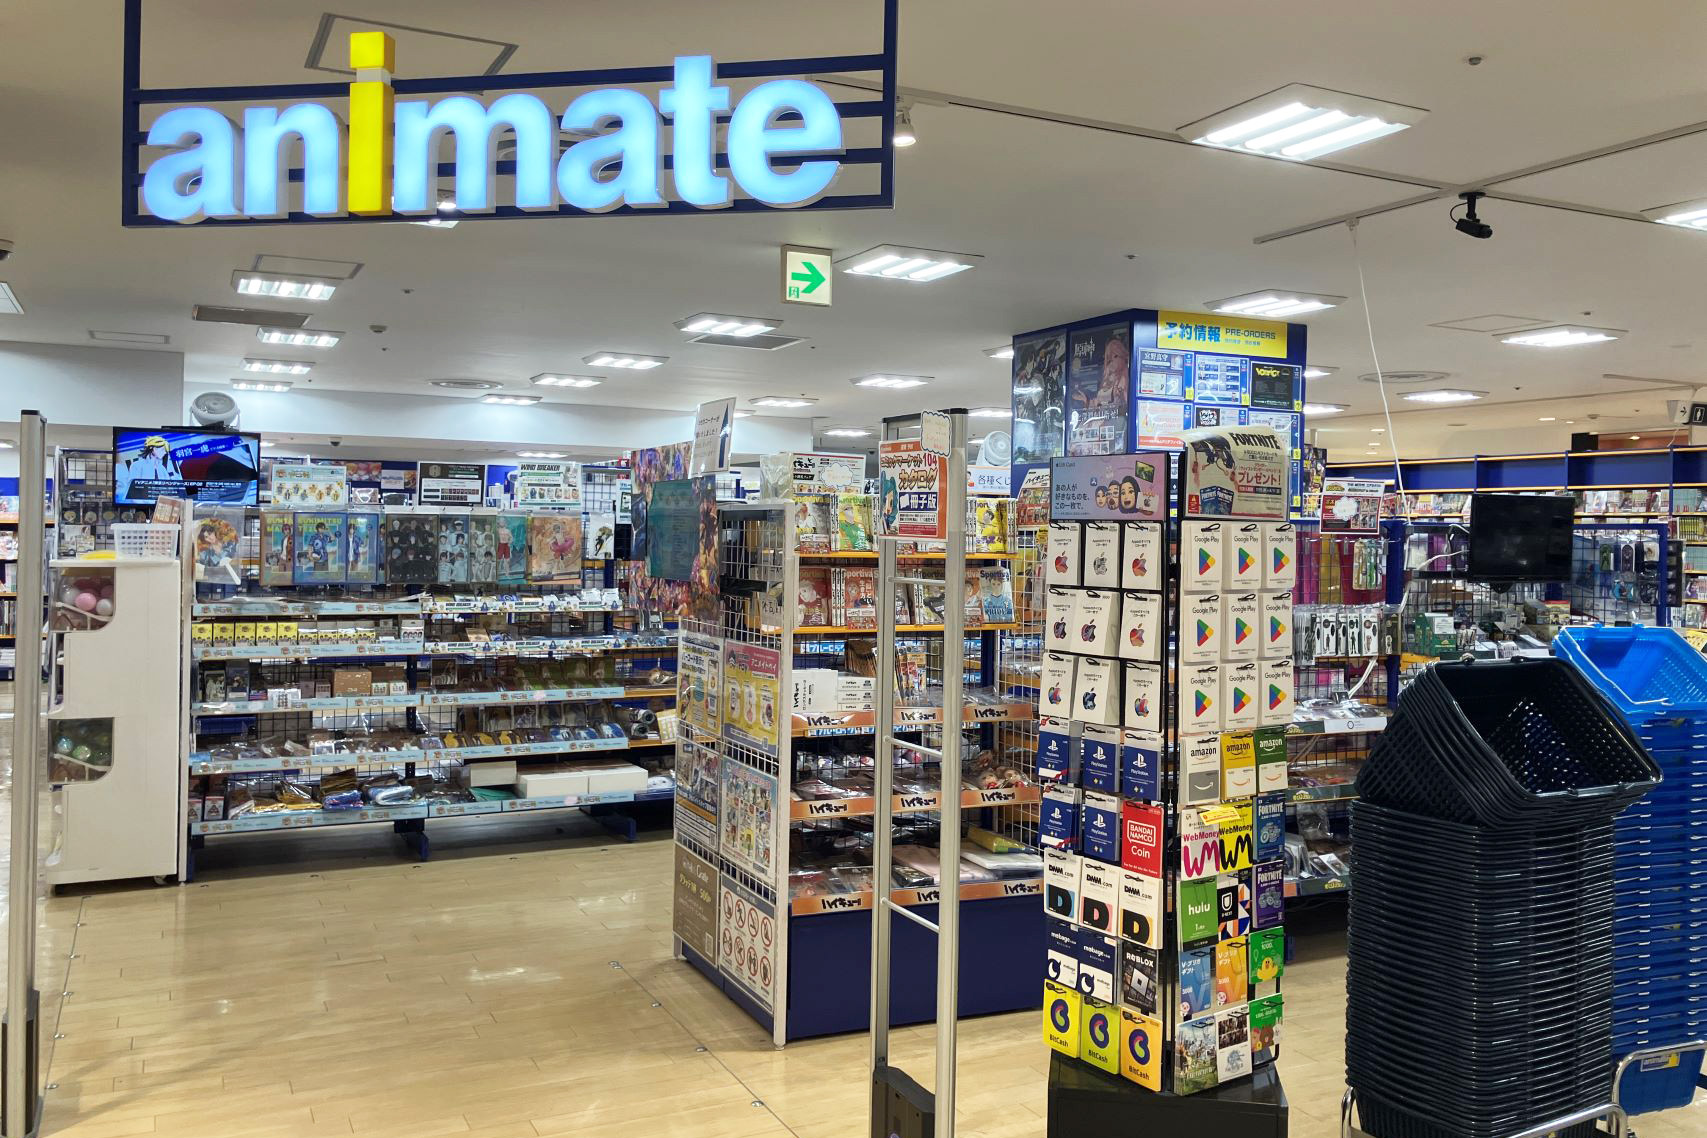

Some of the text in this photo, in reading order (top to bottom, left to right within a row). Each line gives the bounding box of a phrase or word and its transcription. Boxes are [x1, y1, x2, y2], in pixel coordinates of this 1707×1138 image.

[142, 31, 843, 220] animate
[1165, 321, 1221, 343] 予約情報
[1225, 327, 1276, 340] PRE-ORDERS
[1228, 432, 1281, 450] FORTNITE
[923, 453, 938, 467] 104
[899, 467, 939, 490] カタログ
[1238, 471, 1281, 486] プレゼント!
[1055, 483, 1078, 491] あの人が
[910, 494, 937, 509] 冊子版
[1194, 535, 1210, 543] Google
[1233, 535, 1248, 543] Google
[1268, 535, 1294, 543] Google Play
[1192, 606, 1218, 615] Google Play
[1231, 605, 1245, 614] Google
[1265, 604, 1280, 612] Google
[1190, 677, 1207, 685] Google
[1226, 742, 1251, 752] amazon
[1259, 738, 1283, 748] amazon
[1190, 747, 1217, 757] amazon
[1258, 802, 1284, 817] FORTNITE
[1129, 824, 1153, 835] BANDAI
[1220, 824, 1253, 835] WebMoney
[1129, 831, 1153, 843] NAMCO
[1183, 831, 1220, 842] WebMoney
[1131, 845, 1151, 859] Coin
[1257, 869, 1283, 885] FORTNITE
[1188, 902, 1211, 916] hulu
[1126, 952, 1154, 968] ROBLOX
[1049, 1034, 1069, 1048] BitCash
[1088, 1049, 1108, 1064] BitCash
[1128, 1066, 1150, 1081] BitCash
